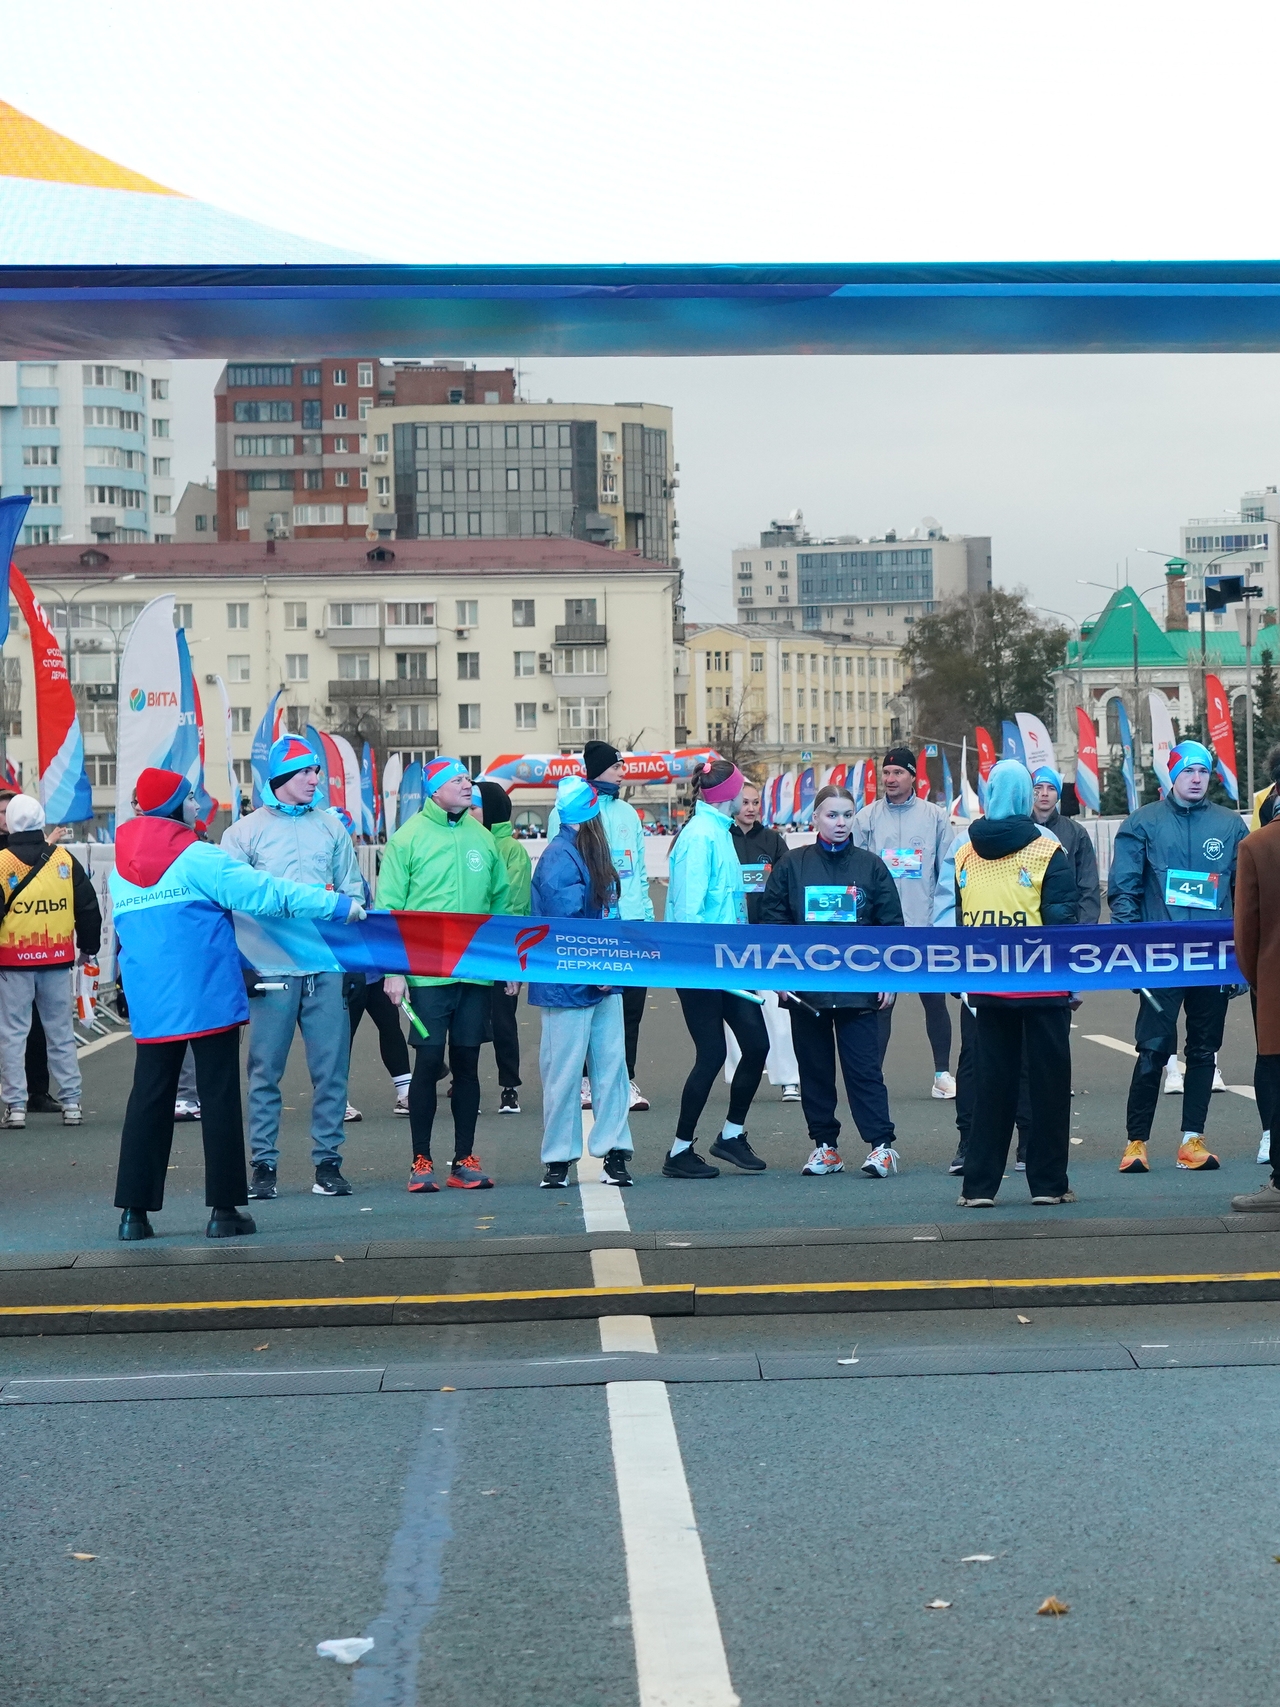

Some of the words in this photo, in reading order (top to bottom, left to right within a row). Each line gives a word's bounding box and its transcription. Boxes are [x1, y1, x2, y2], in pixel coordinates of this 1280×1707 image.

[147, 691, 178, 708] ВИТА
[534, 764, 588, 776] САМАРС
[620, 760, 682, 774] ОБЛАСТЬ
[891, 858, 912, 867] 3-2
[743, 873, 763, 882] 5-2
[1179, 882, 1204, 895] 4-1
[115, 885, 191, 909] #АРЕНАИДЕЙ
[819, 896, 842, 908] 5-1
[13, 898, 68, 915] СУДЬЯ
[963, 910, 1027, 927] СУДЬЯ
[555, 934, 619, 946] РОССИЯ
[17, 952, 48, 961] VOLGA
[556, 946, 661, 960] СПОРТИВНАЯ
[714, 938, 1051, 974] МАССОВЫЙ
[556, 960, 634, 972] ДЕРЖАВА
